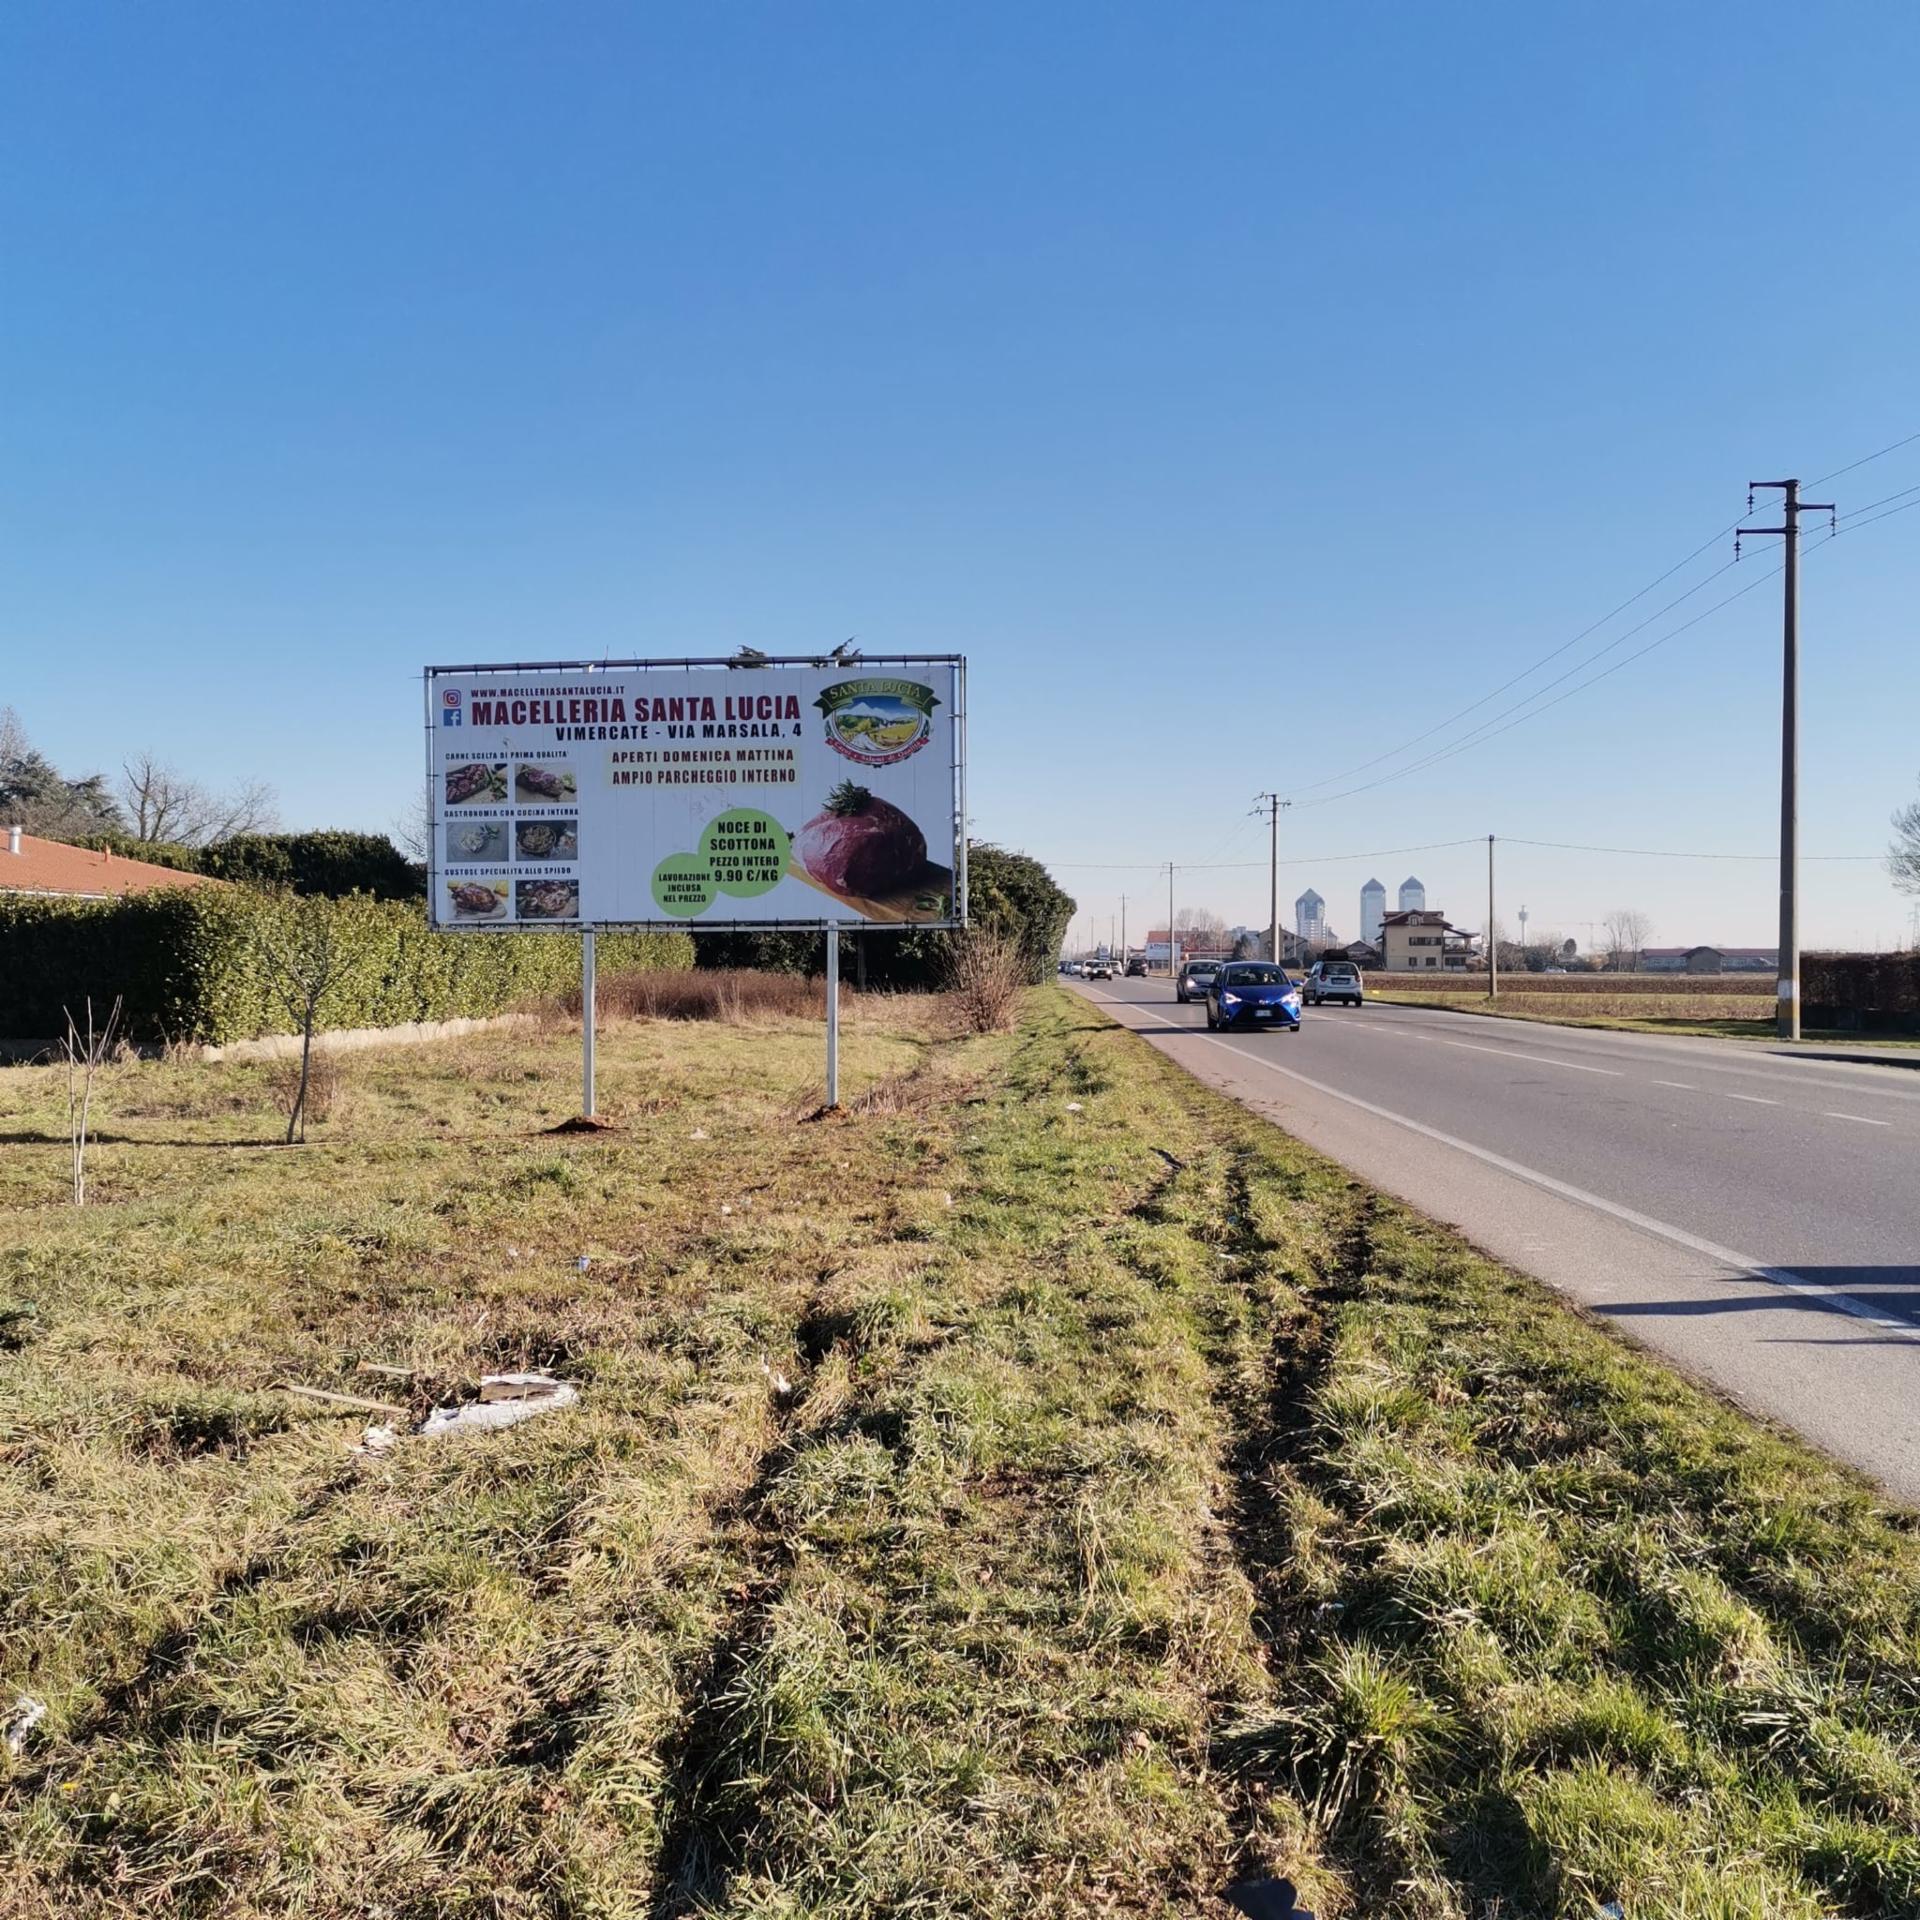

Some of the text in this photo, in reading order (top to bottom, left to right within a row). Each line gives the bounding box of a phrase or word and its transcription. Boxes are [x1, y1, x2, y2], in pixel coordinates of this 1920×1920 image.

[471, 686, 625, 698] WWW.MACELLERIASANTALUCIA.IT
[830, 682, 921, 700] SANTA LUCIA
[472, 695, 800, 726] MACELLERIA SANTA LUCIA
[556, 725, 648, 741] VIMERCATE
[668, 724, 696, 739] VIA
[703, 724, 786, 739] MARSALA,
[792, 722, 802, 737] 4
[445, 752, 469, 760] CARNE
[472, 752, 498, 760] SCELTA
[510, 751, 534, 759] PRIMA
[612, 750, 794, 764] APERTI DOMENICA MATTINA
[612, 768, 796, 784] AMPIO PARCHEGGIO INTERNO
[444, 808, 579, 818] GASTRONOMIA CON CUCINA INTERNA
[718, 821, 767, 834] NOCE DI
[710, 838, 776, 852] SCOTTONA
[710, 856, 780, 867] PEZZO INTERO
[544, 866, 572, 874] SPIEDO
[714, 870, 743, 882] 9.90
[658, 872, 710, 882] LAVORAZIONE
[668, 884, 702, 892] INCLUSA
[663, 892, 707, 903] NEL PREZZO
